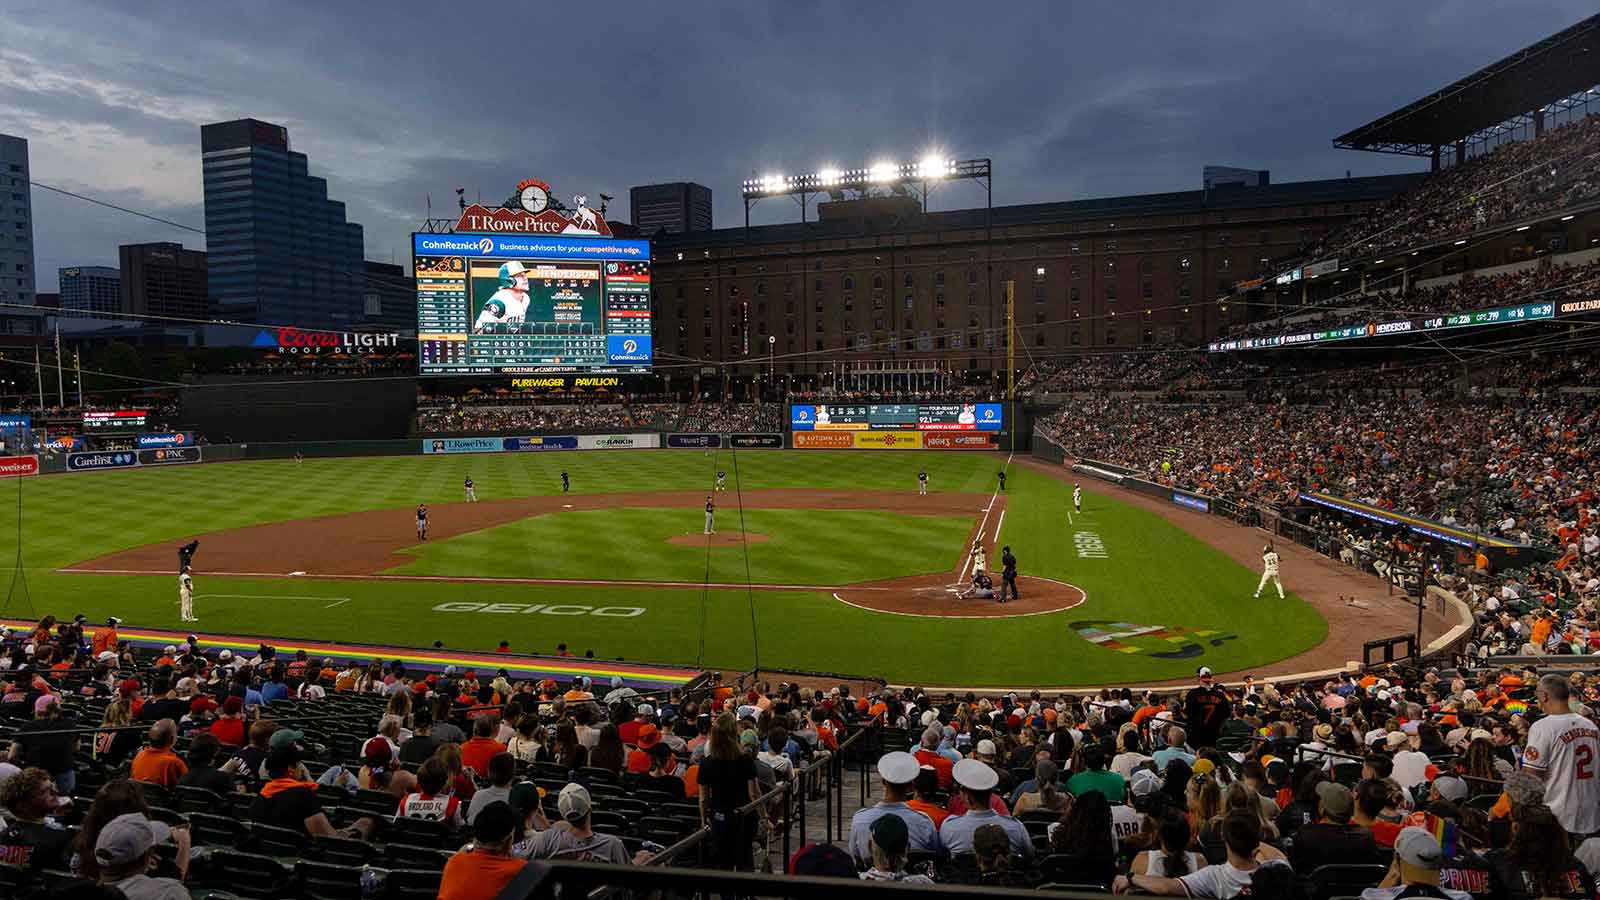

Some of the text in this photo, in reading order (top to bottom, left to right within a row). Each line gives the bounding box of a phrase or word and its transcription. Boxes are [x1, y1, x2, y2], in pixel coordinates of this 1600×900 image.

[422, 240, 479, 250] CohnReznick
[567, 246, 583, 254] your
[583, 246, 622, 254] competitive
[1561, 301, 1585, 313] ORIOLE
[1376, 321, 1412, 334] HENDERSON
[1516, 308, 1525, 317] 16
[1541, 305, 1552, 315] 39
[277, 324, 399, 347] Coors LIGHT
[335, 346, 375, 354] DECK
[511, 378, 619, 387] PUREWAGER PAVILION
[166, 450, 185, 458] PNC
[75, 455, 114, 467] CareFirst
[432, 602, 646, 617] GEICO
[1576, 744, 1594, 780] 2
[1440, 868, 1489, 893] PRIDE
